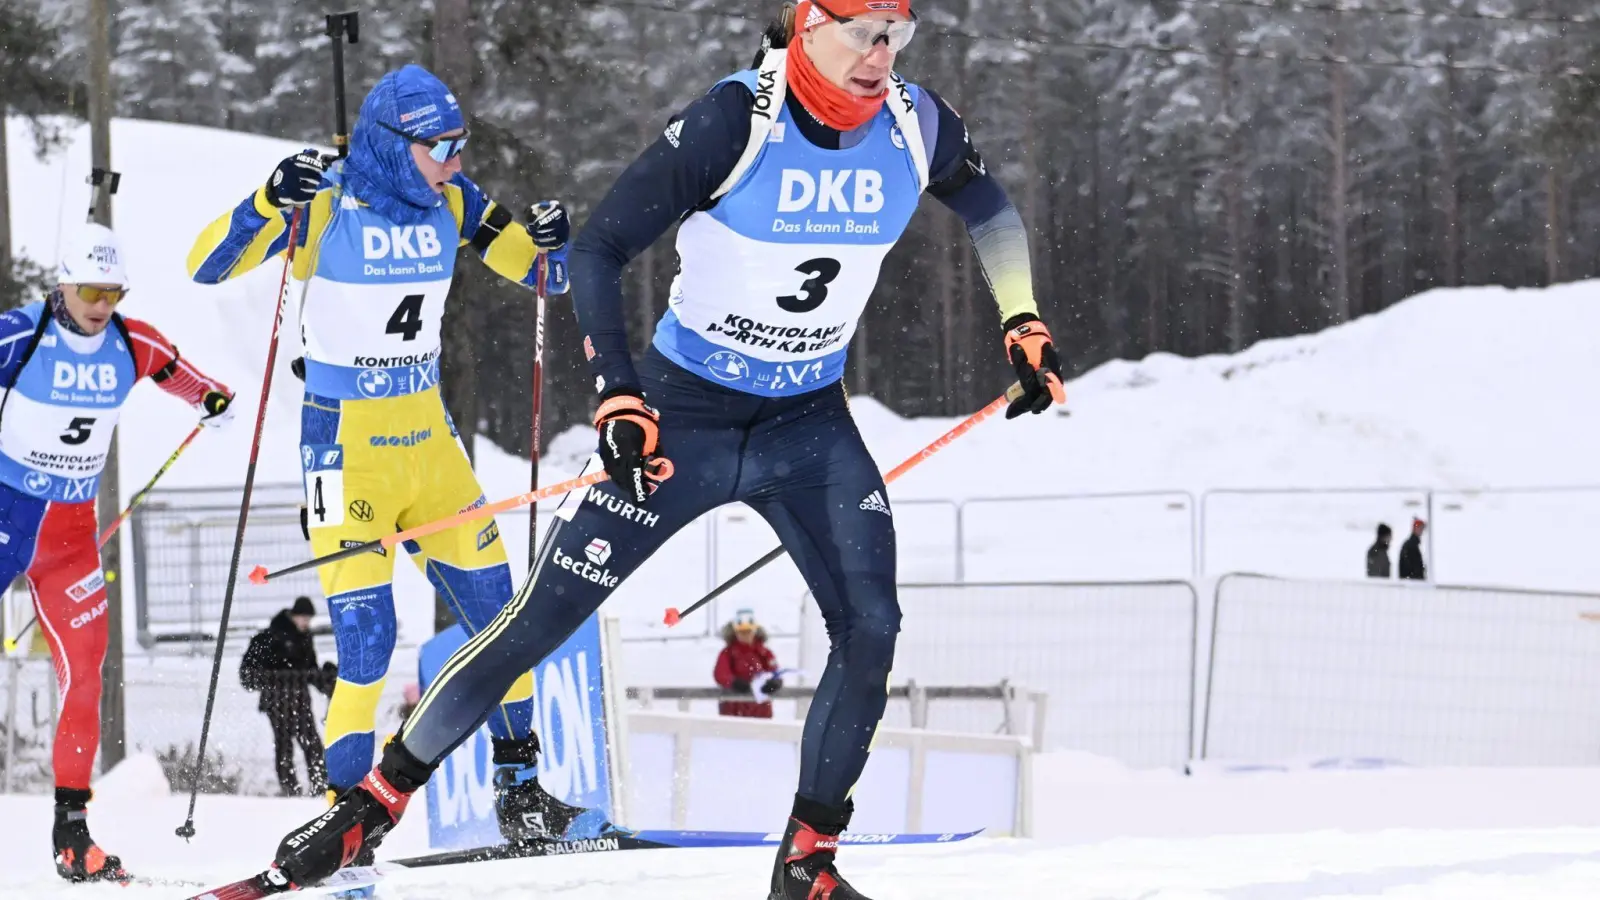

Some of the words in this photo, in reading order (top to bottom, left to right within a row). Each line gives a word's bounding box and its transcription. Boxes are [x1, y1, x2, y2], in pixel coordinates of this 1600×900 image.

[751, 70, 777, 120] JOKA
[777, 168, 884, 213] DKB
[363, 225, 441, 260] DKB
[772, 219, 800, 233] Das
[805, 219, 840, 233] kann
[845, 220, 880, 235] Bank
[364, 263, 387, 276] Das
[389, 263, 415, 275] kann
[418, 261, 443, 274] Bank
[776, 257, 841, 313] 3
[385, 294, 425, 342] 4
[53, 361, 118, 391] DKB
[60, 417, 97, 445] 5
[314, 476, 326, 522] 4
[588, 487, 660, 528] WÜRTH
[859, 502, 891, 516] adidas
[552, 547, 619, 588] tectake
[367, 771, 399, 804] DSHUS
[286, 801, 346, 849] ADSHUS
[546, 838, 619, 855] SALOMON
